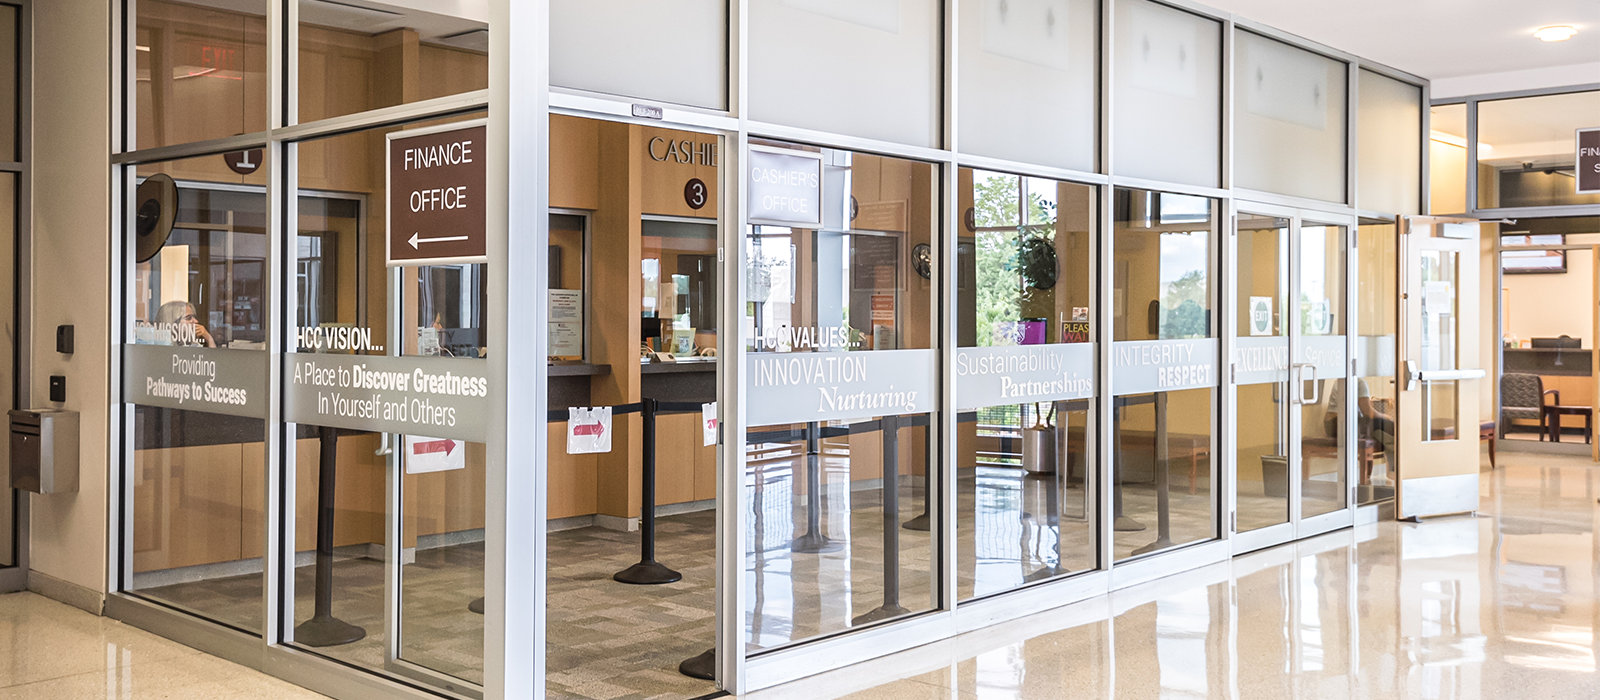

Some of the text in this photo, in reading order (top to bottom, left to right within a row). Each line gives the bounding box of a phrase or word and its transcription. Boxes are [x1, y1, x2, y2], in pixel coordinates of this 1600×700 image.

[404, 140, 473, 171] FINANCE
[648, 136, 717, 167] CASHIE
[751, 166, 818, 188] CASHIER'S
[410, 185, 467, 213] OFFICE
[692, 183, 704, 206] 3
[762, 195, 808, 213] OFFICE
[1255, 310, 1268, 322] EXIT
[296, 326, 384, 351] HCC VISION...
[754, 327, 788, 349] HCC
[790, 326, 861, 349] VALUES...
[172, 354, 216, 382] Providing
[957, 347, 1064, 376] Sustainability
[1115, 343, 1194, 367] INTEGRITY
[1236, 346, 1288, 372] EXCELLENCE
[1304, 346, 1341, 367] Service
[293, 361, 488, 397] A Place to Discover Greatness
[754, 355, 867, 387] INNOVATION
[1000, 371, 1092, 398] Partnerships
[1158, 364, 1211, 387] RESPECT
[146, 376, 247, 405] Pathways to Success
[817, 384, 918, 413] Nurturing
[318, 391, 456, 427] In Yourself and Others
